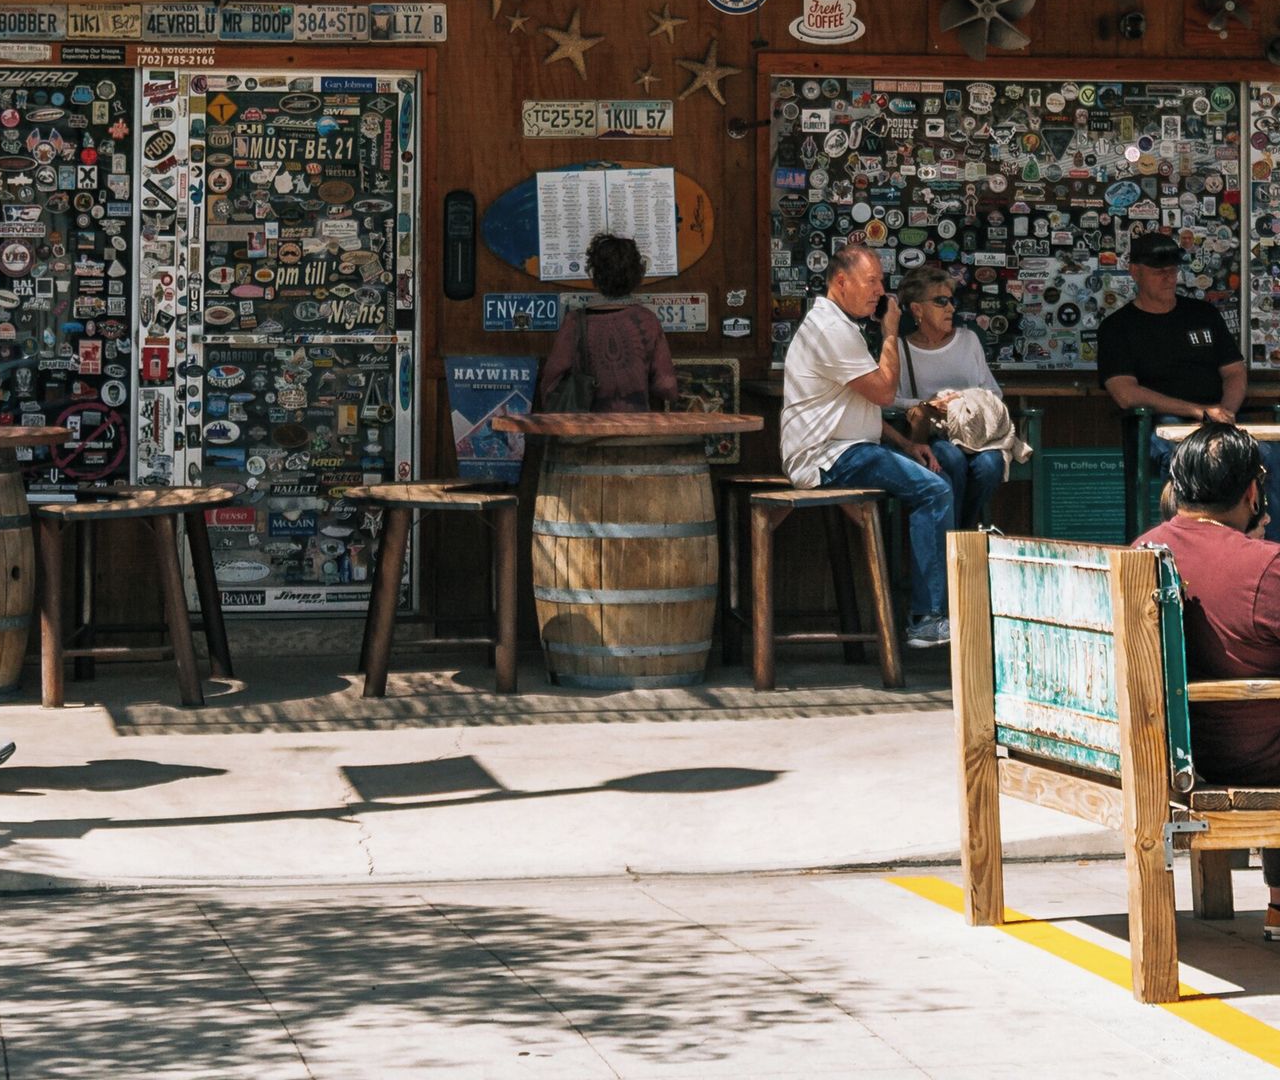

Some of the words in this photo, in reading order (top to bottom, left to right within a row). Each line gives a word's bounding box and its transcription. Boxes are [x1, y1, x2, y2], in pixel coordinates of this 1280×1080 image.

[390, 5, 424, 13] NEVADA
[809, 0, 844, 13] Fresh
[70, 14, 100, 33] TIKI
[147, 14, 215, 34] 4EVRBLU
[223, 15, 242, 33] MR
[252, 15, 291, 33] BOOP
[392, 15, 422, 33] LIZ
[434, 16, 443, 33] B
[808, 13, 844, 28] COFFEE
[137, 47, 160, 55] K.M.A.
[161, 47, 216, 55] MOTORSPORTS
[137, 55, 164, 67] (702)
[166, 55, 215, 65] 785-2166
[324, 79, 343, 90] Gary
[343, 78, 373, 88] Johnson
[606, 110, 643, 128] 1KUL
[647, 110, 666, 129] 57
[236, 123, 264, 134] PJ1
[145, 132, 175, 159] FUBO
[212, 136, 228, 145] 101
[250, 137, 299, 160] MUST
[334, 137, 353, 160] 21
[13, 280, 34, 288] RAL
[13, 288, 34, 296] CIA
[359, 352, 388, 362] Vegas
[453, 369, 530, 381] HAYWIRE
[1053, 461, 1069, 470] The
[1070, 461, 1097, 470] Coffee
[1100, 462, 1117, 472] Cup
[273, 484, 319, 494] HALLETT
[222, 592, 265, 605] Beaver
